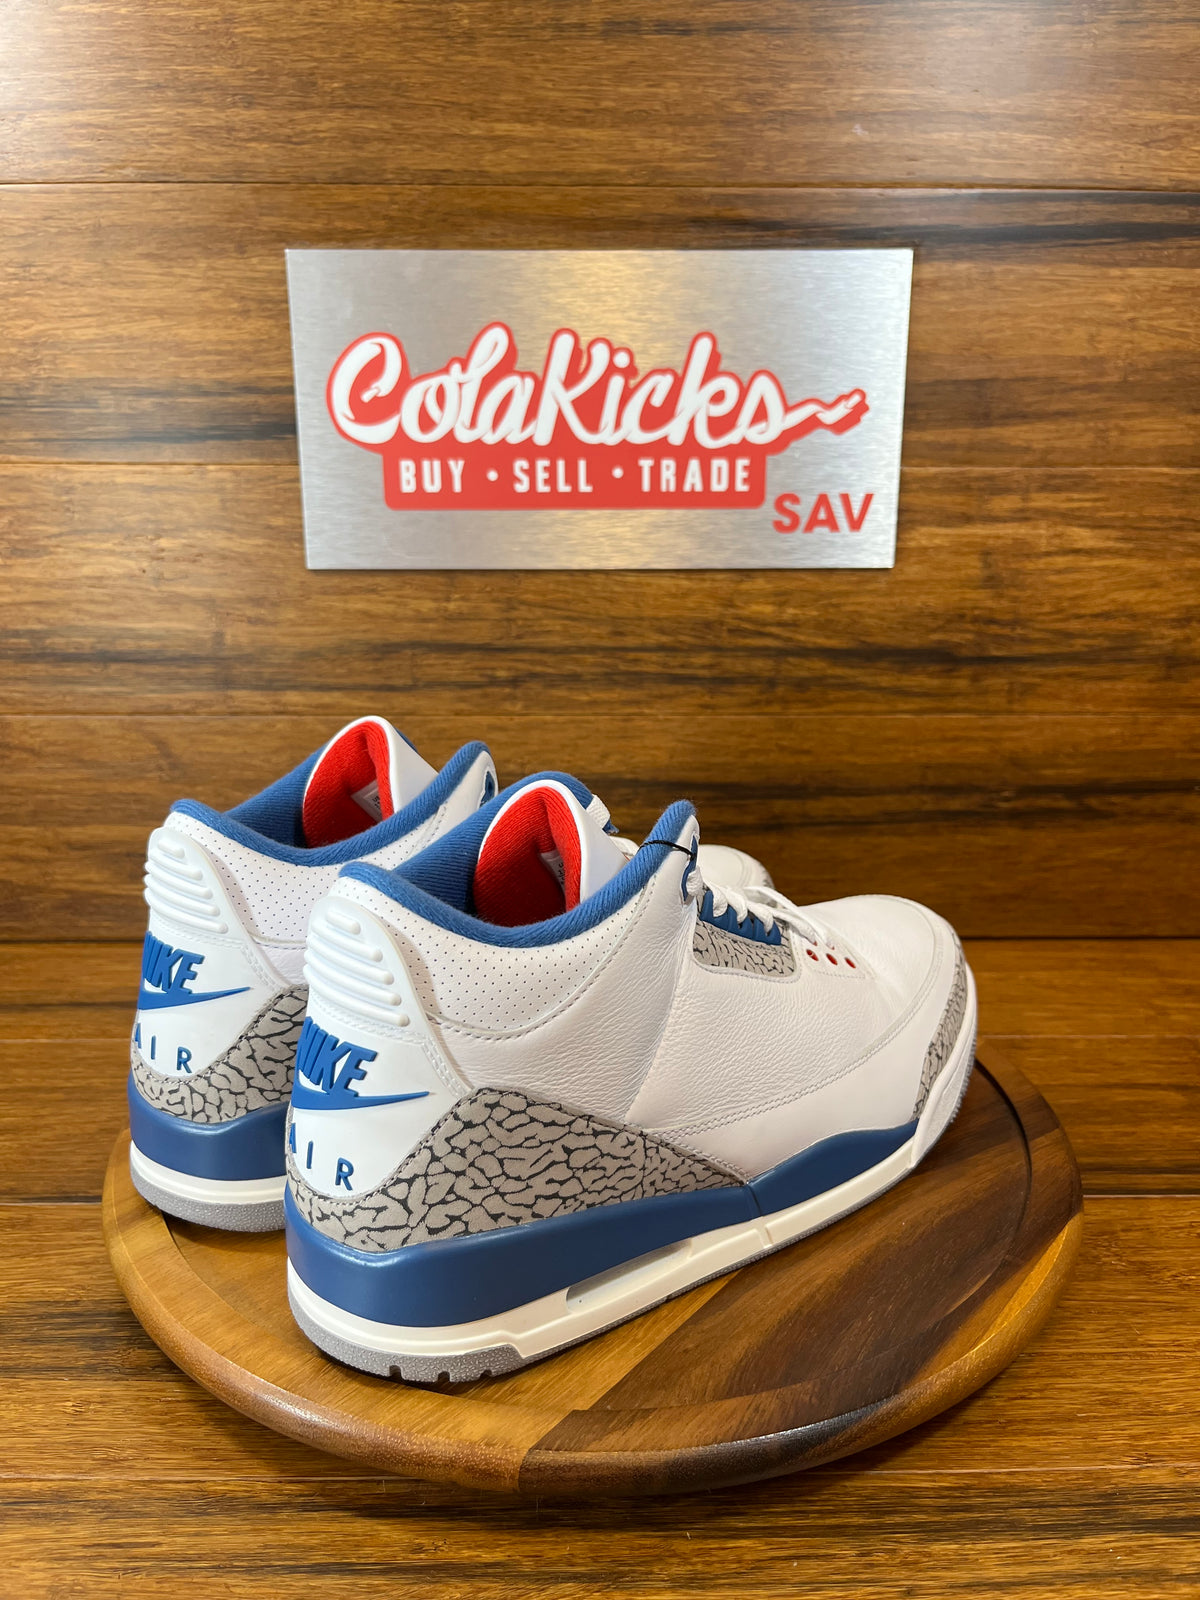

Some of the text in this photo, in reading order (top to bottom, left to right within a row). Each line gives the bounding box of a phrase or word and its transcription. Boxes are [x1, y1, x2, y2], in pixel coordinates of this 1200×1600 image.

[329, 323, 867, 450] ColaKicks
[400, 457, 751, 494] BUY SELL TRADE
[772, 493, 874, 534] SAV
